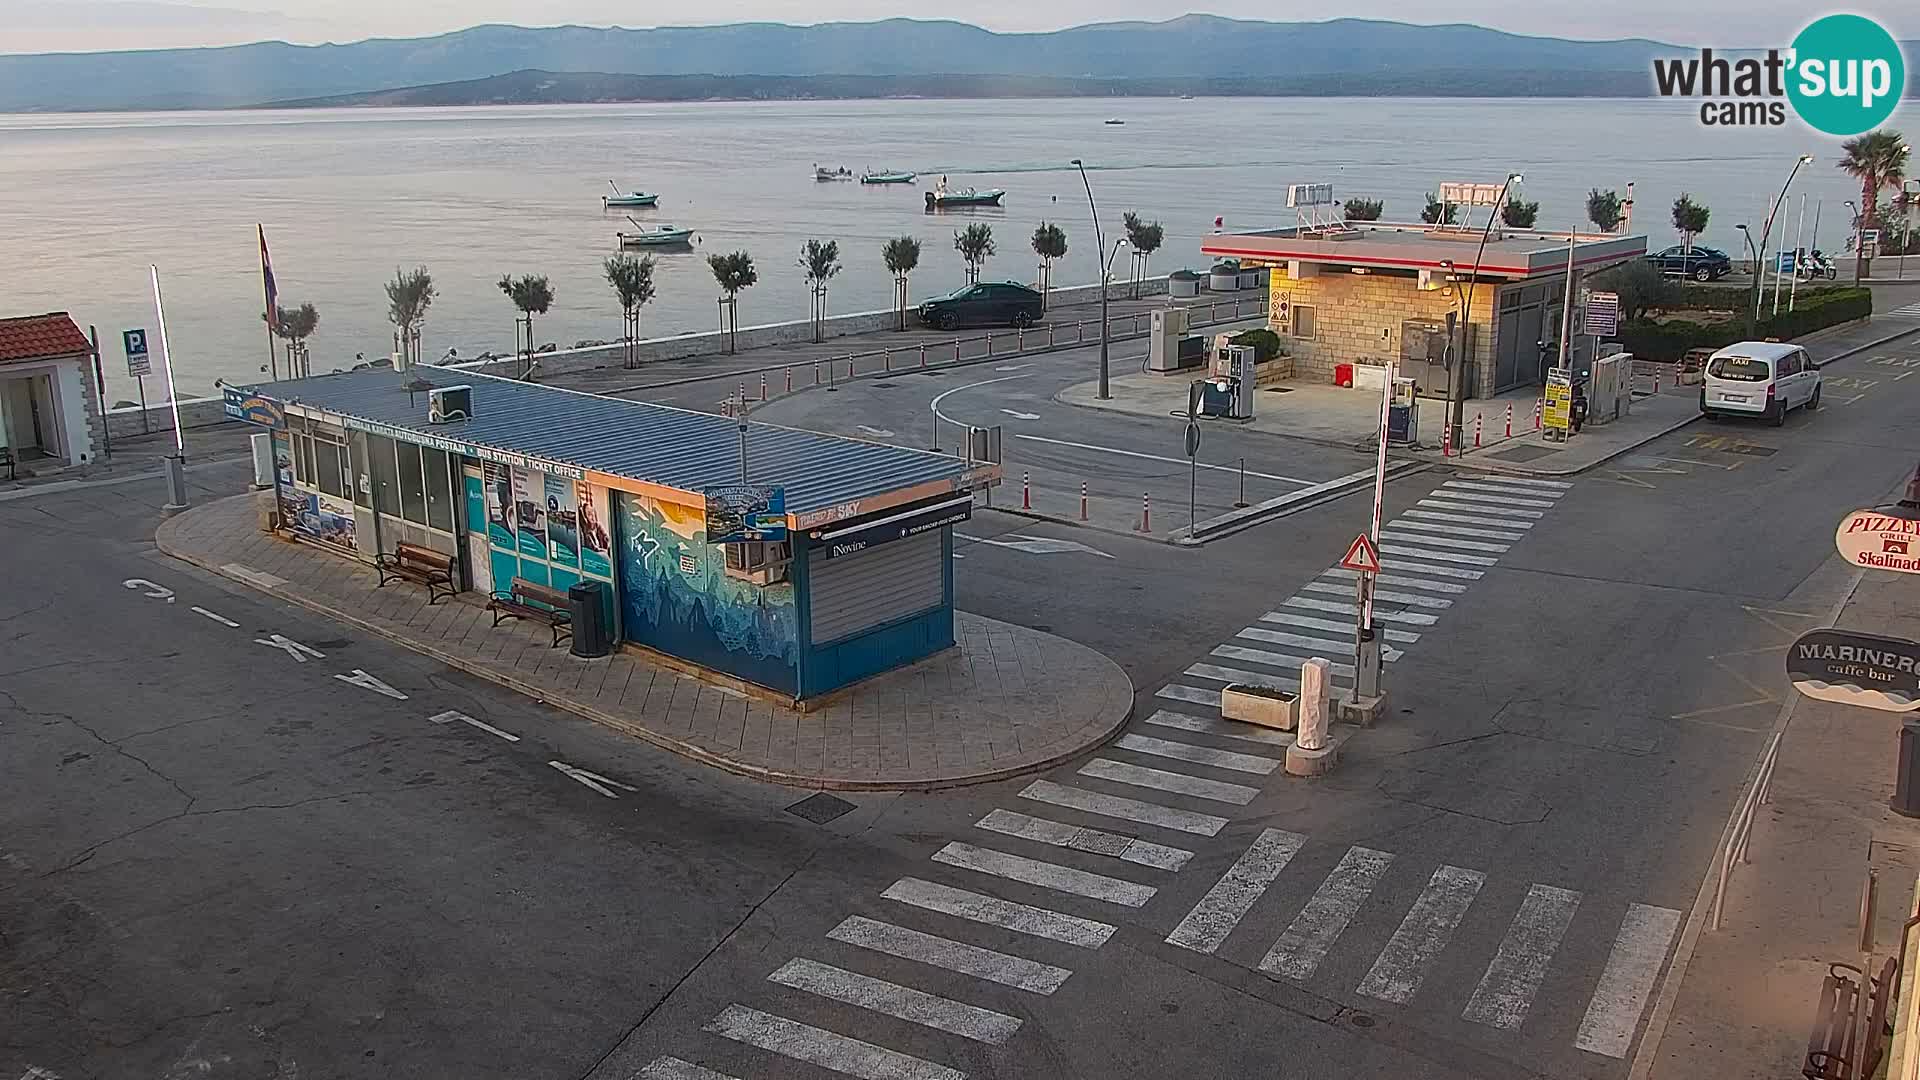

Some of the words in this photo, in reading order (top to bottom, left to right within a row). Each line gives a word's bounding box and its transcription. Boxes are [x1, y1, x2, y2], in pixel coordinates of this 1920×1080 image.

[128, 333, 142, 352] P
[1731, 358, 1749, 366] TAXI
[395, 430, 435, 446] AUTOBUSNA
[436, 438, 466, 454] POSTAJA
[477, 448, 492, 459] BUS
[493, 452, 525, 467] STATION
[527, 459, 554, 473] TICKET
[554, 465, 581, 479] OFFICE
[837, 502, 860, 519] SKY
[1879, 532, 1915, 543] GRILL
[833, 540, 867, 558] iNovine
[1857, 551, 1920, 571] Skalinad
[1827, 663, 1864, 677] caffe
[1869, 667, 1895, 682] bar
